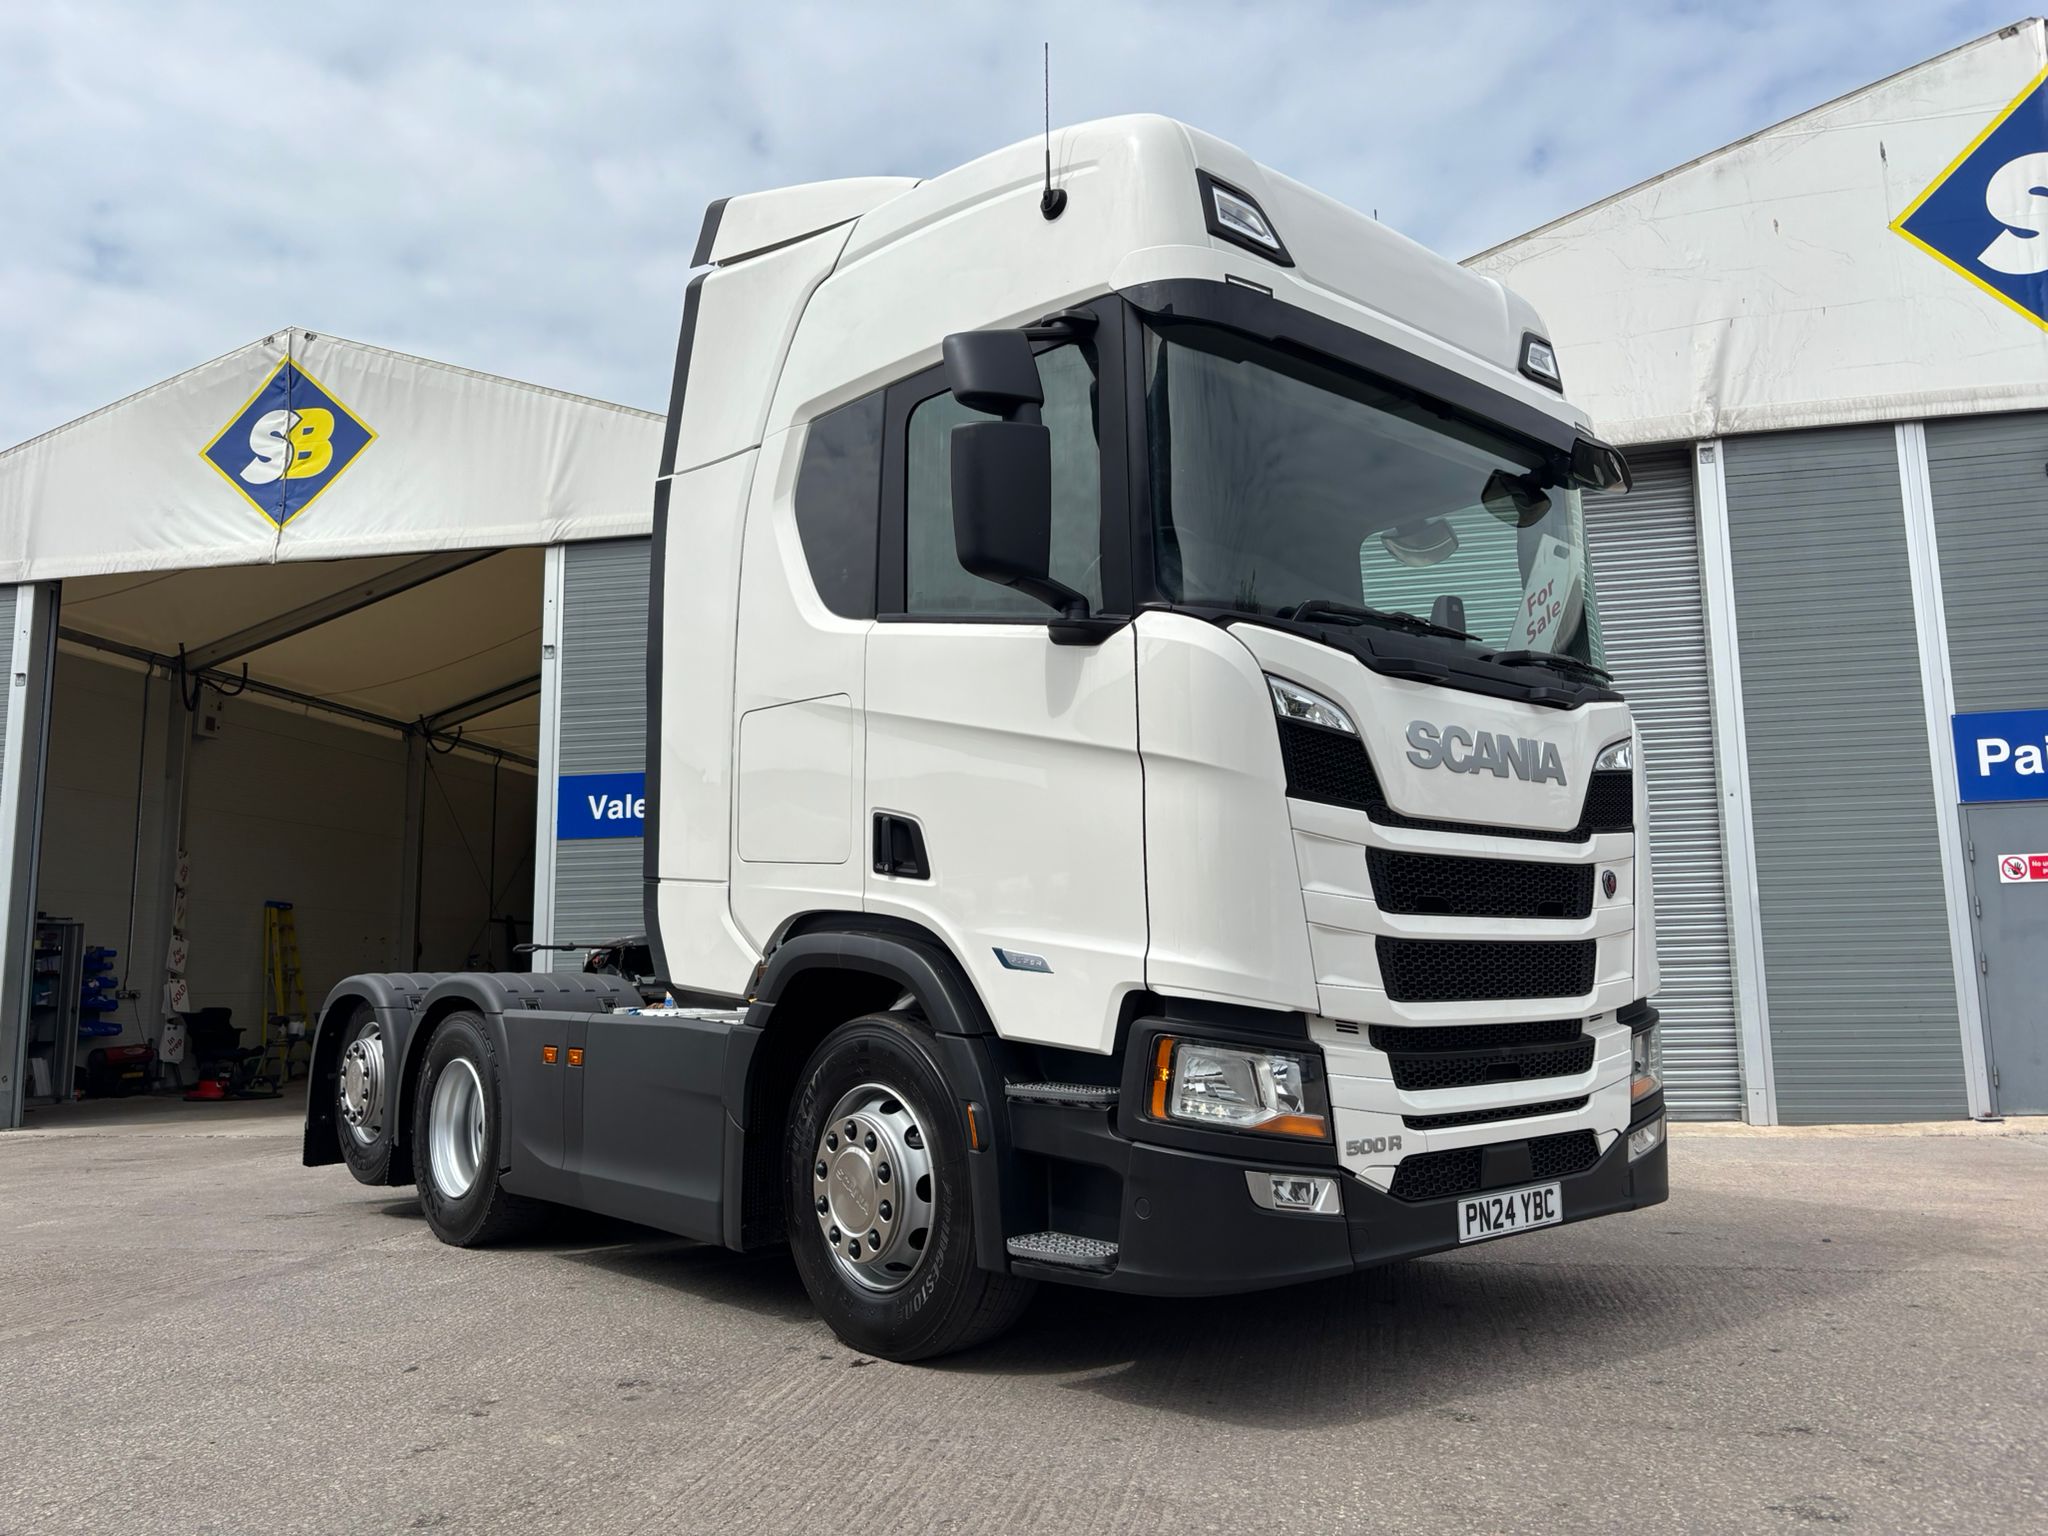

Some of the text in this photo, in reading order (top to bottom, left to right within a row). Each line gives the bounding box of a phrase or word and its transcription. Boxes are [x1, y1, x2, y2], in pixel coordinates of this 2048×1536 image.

[240, 408, 335, 485] SB
[1527, 578, 1554, 617] For
[1527, 601, 1560, 645] Sale
[1406, 720, 1567, 786] SCANIA
[173, 984, 187, 1006] SOLD
[168, 1039, 183, 1056] Prep
[1346, 1135, 1402, 1156] 500 R
[1465, 1188, 1555, 1235] PN24 YBC
